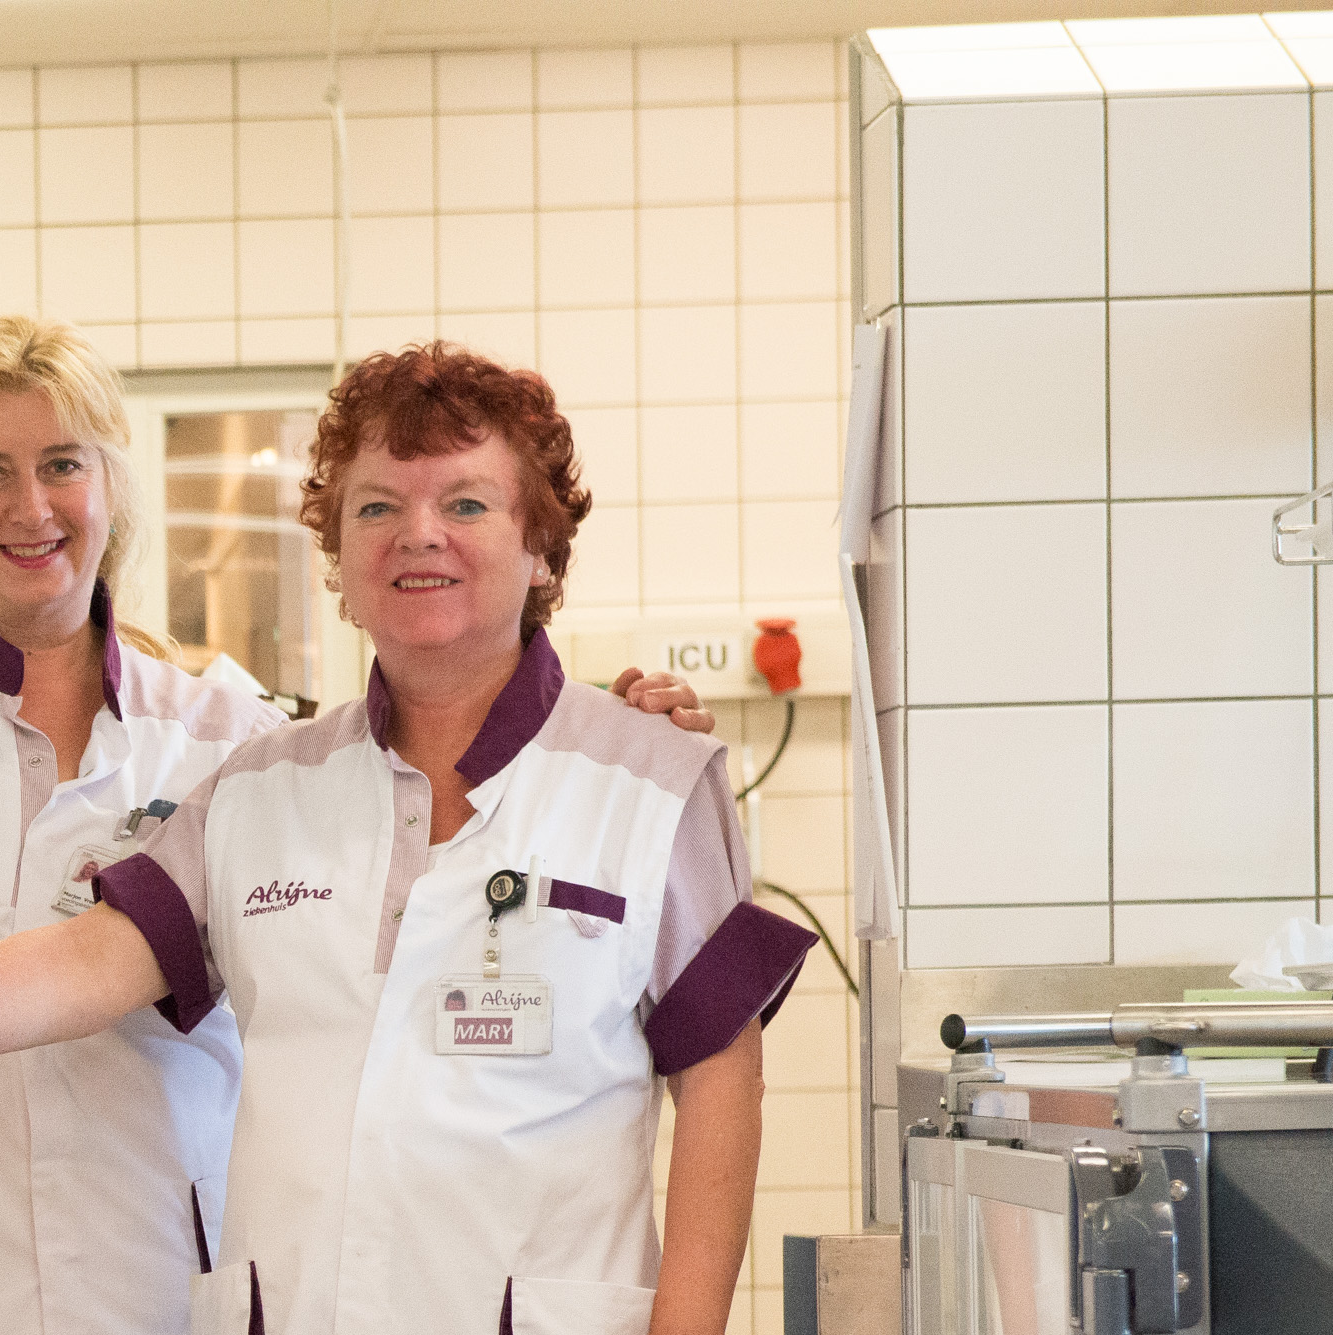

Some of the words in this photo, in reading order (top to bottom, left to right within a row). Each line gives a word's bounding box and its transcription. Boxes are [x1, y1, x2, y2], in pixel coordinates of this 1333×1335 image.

[669, 644, 727, 672] ICU
[245, 880, 333, 907] Alrijne
[480, 989, 542, 1011] Alrijne
[454, 1023, 513, 1041] MARY
